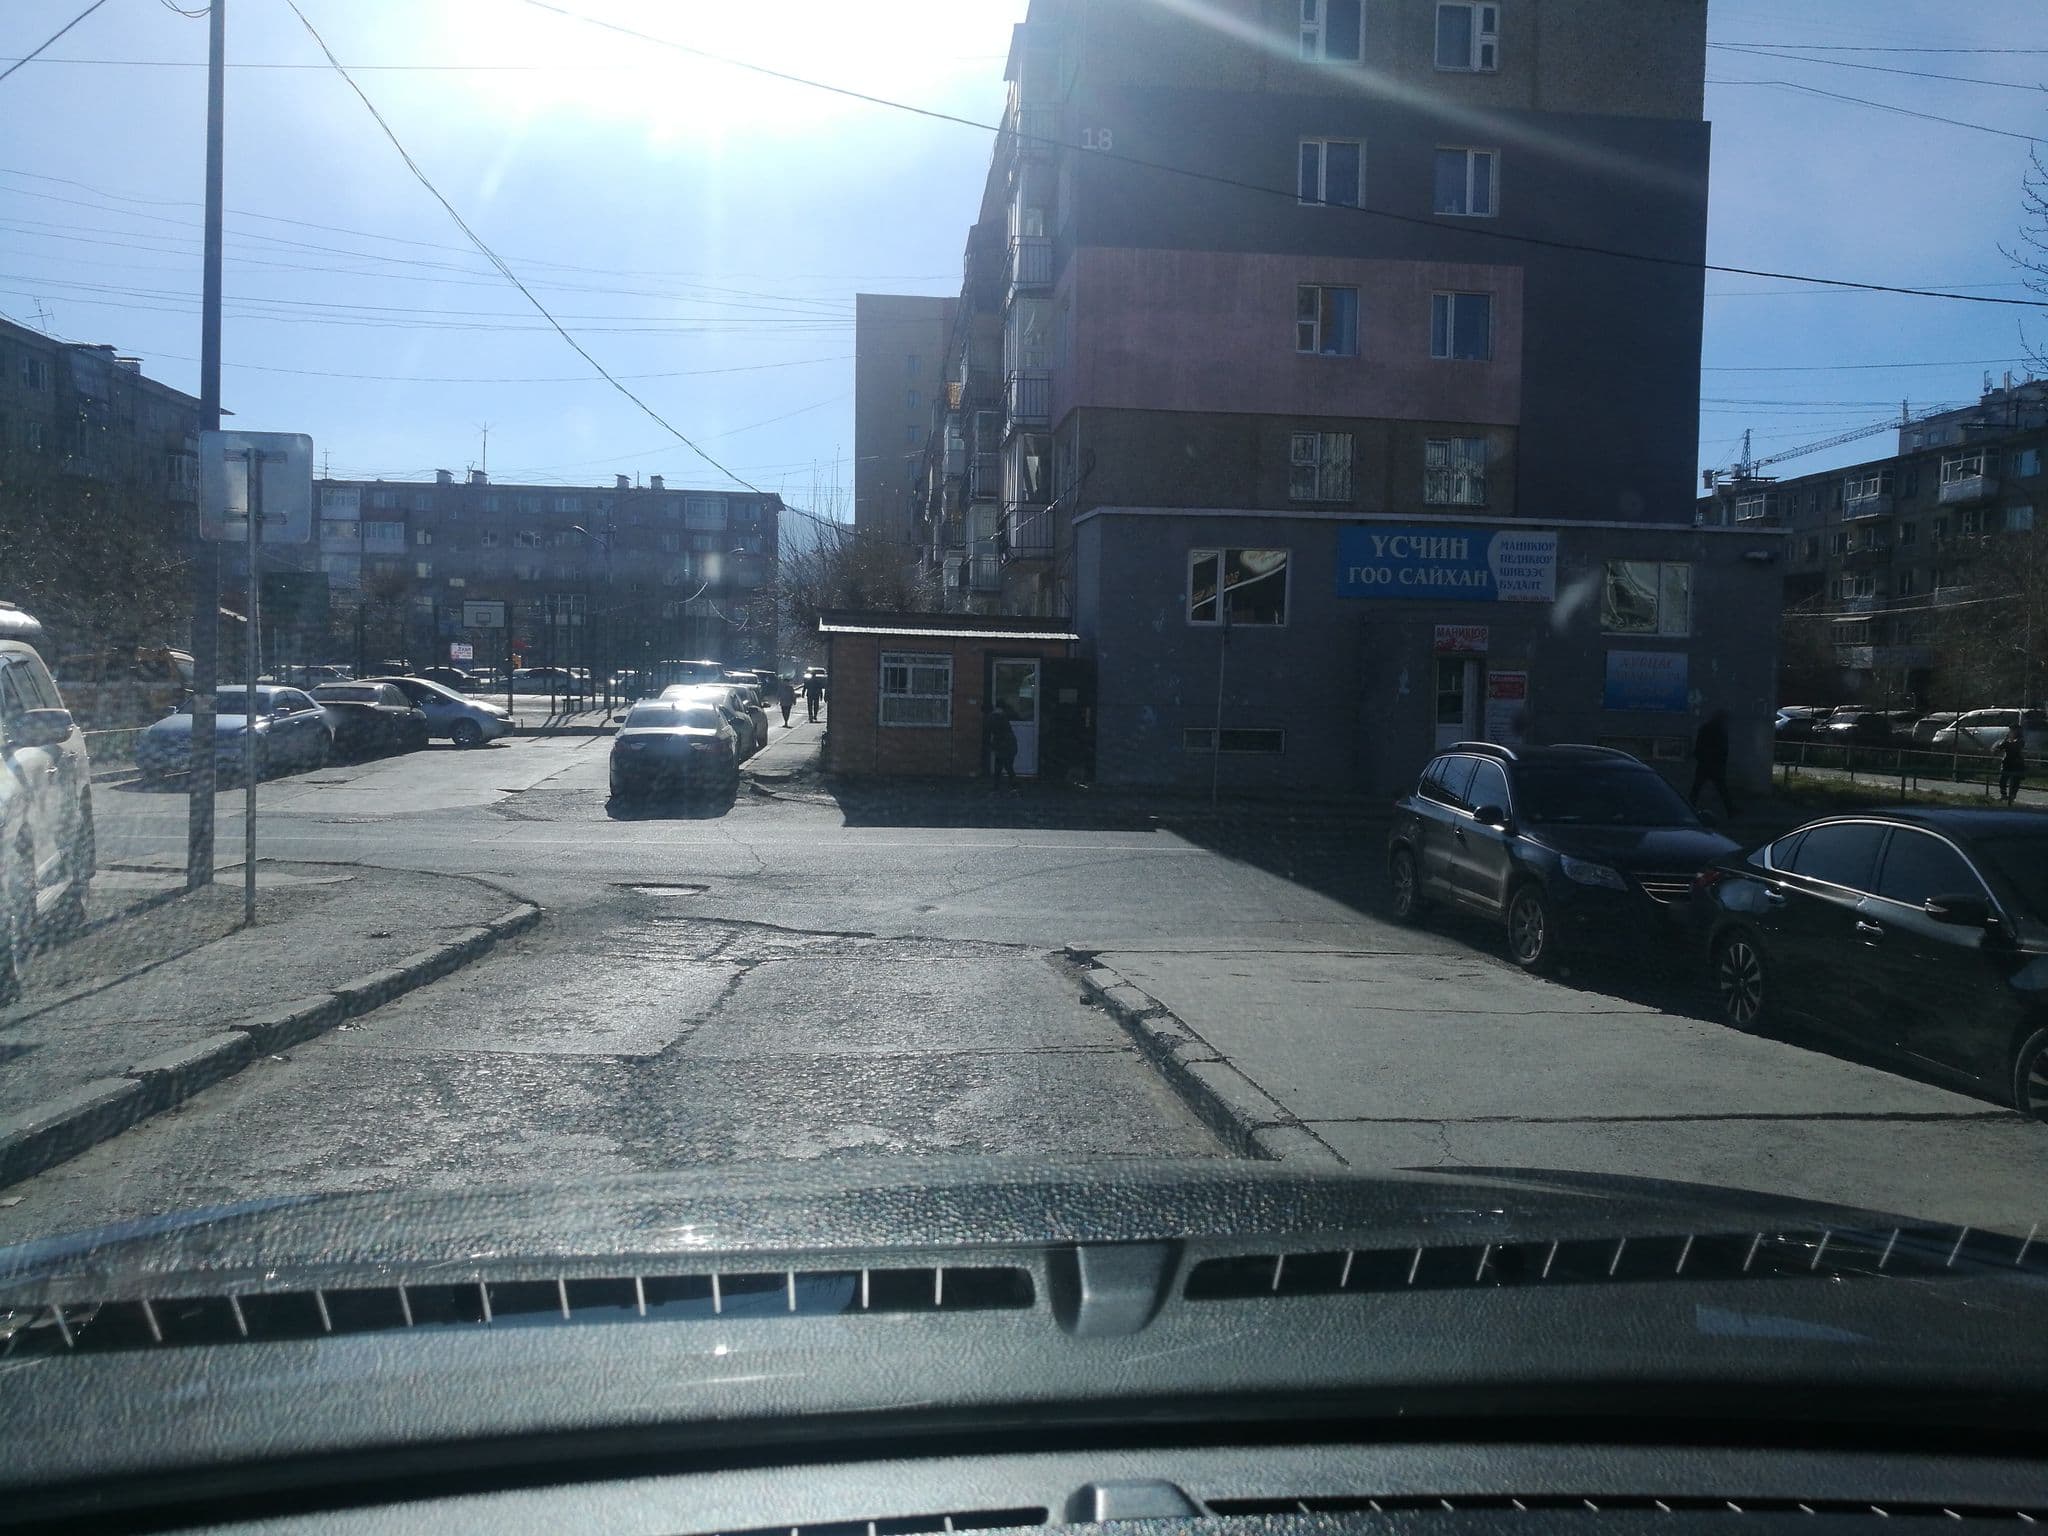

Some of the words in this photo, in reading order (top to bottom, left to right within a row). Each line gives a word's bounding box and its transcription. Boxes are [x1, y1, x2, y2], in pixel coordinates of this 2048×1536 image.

[1370, 535, 1470, 560] ҮСЧИН
[1500, 541, 1556, 552] МАНИКЮР
[1347, 566, 1393, 585] ГОО
[1398, 566, 1489, 587] САЙХАН
